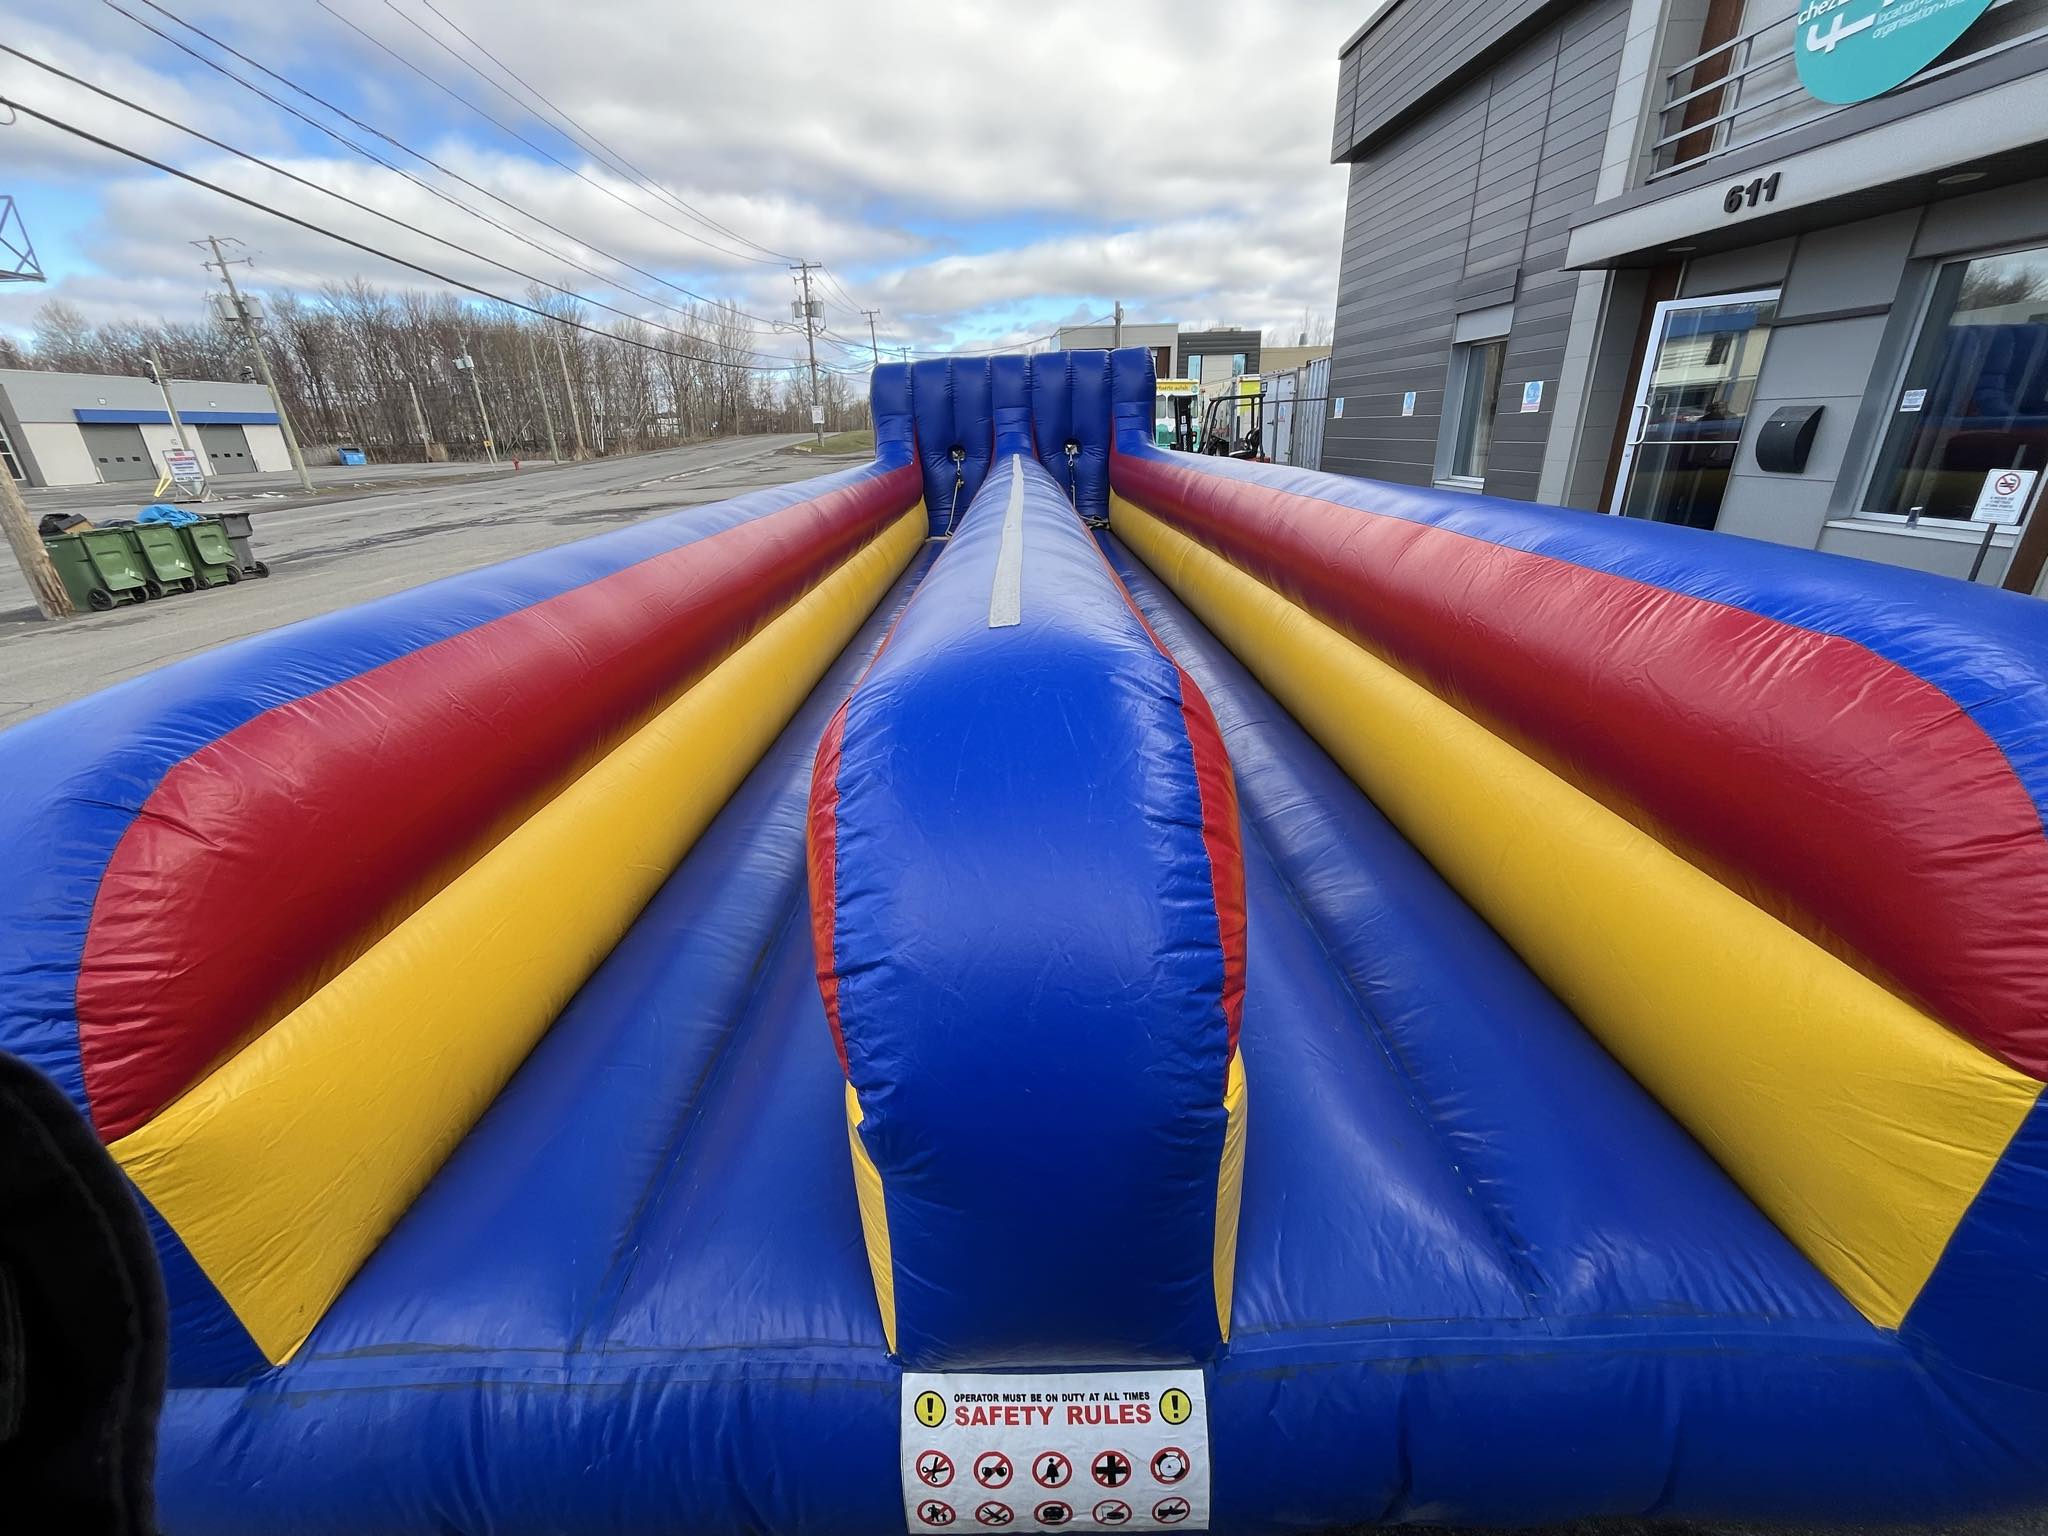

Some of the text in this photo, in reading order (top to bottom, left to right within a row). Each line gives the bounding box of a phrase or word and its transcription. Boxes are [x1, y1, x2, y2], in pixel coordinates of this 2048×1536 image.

[1723, 172, 1782, 213] 611
[954, 1391, 1150, 1402] OPERATOR MUST BE ON DUTY AT ALL TIMES
[954, 1404, 1152, 1426] SAFETY RULES
